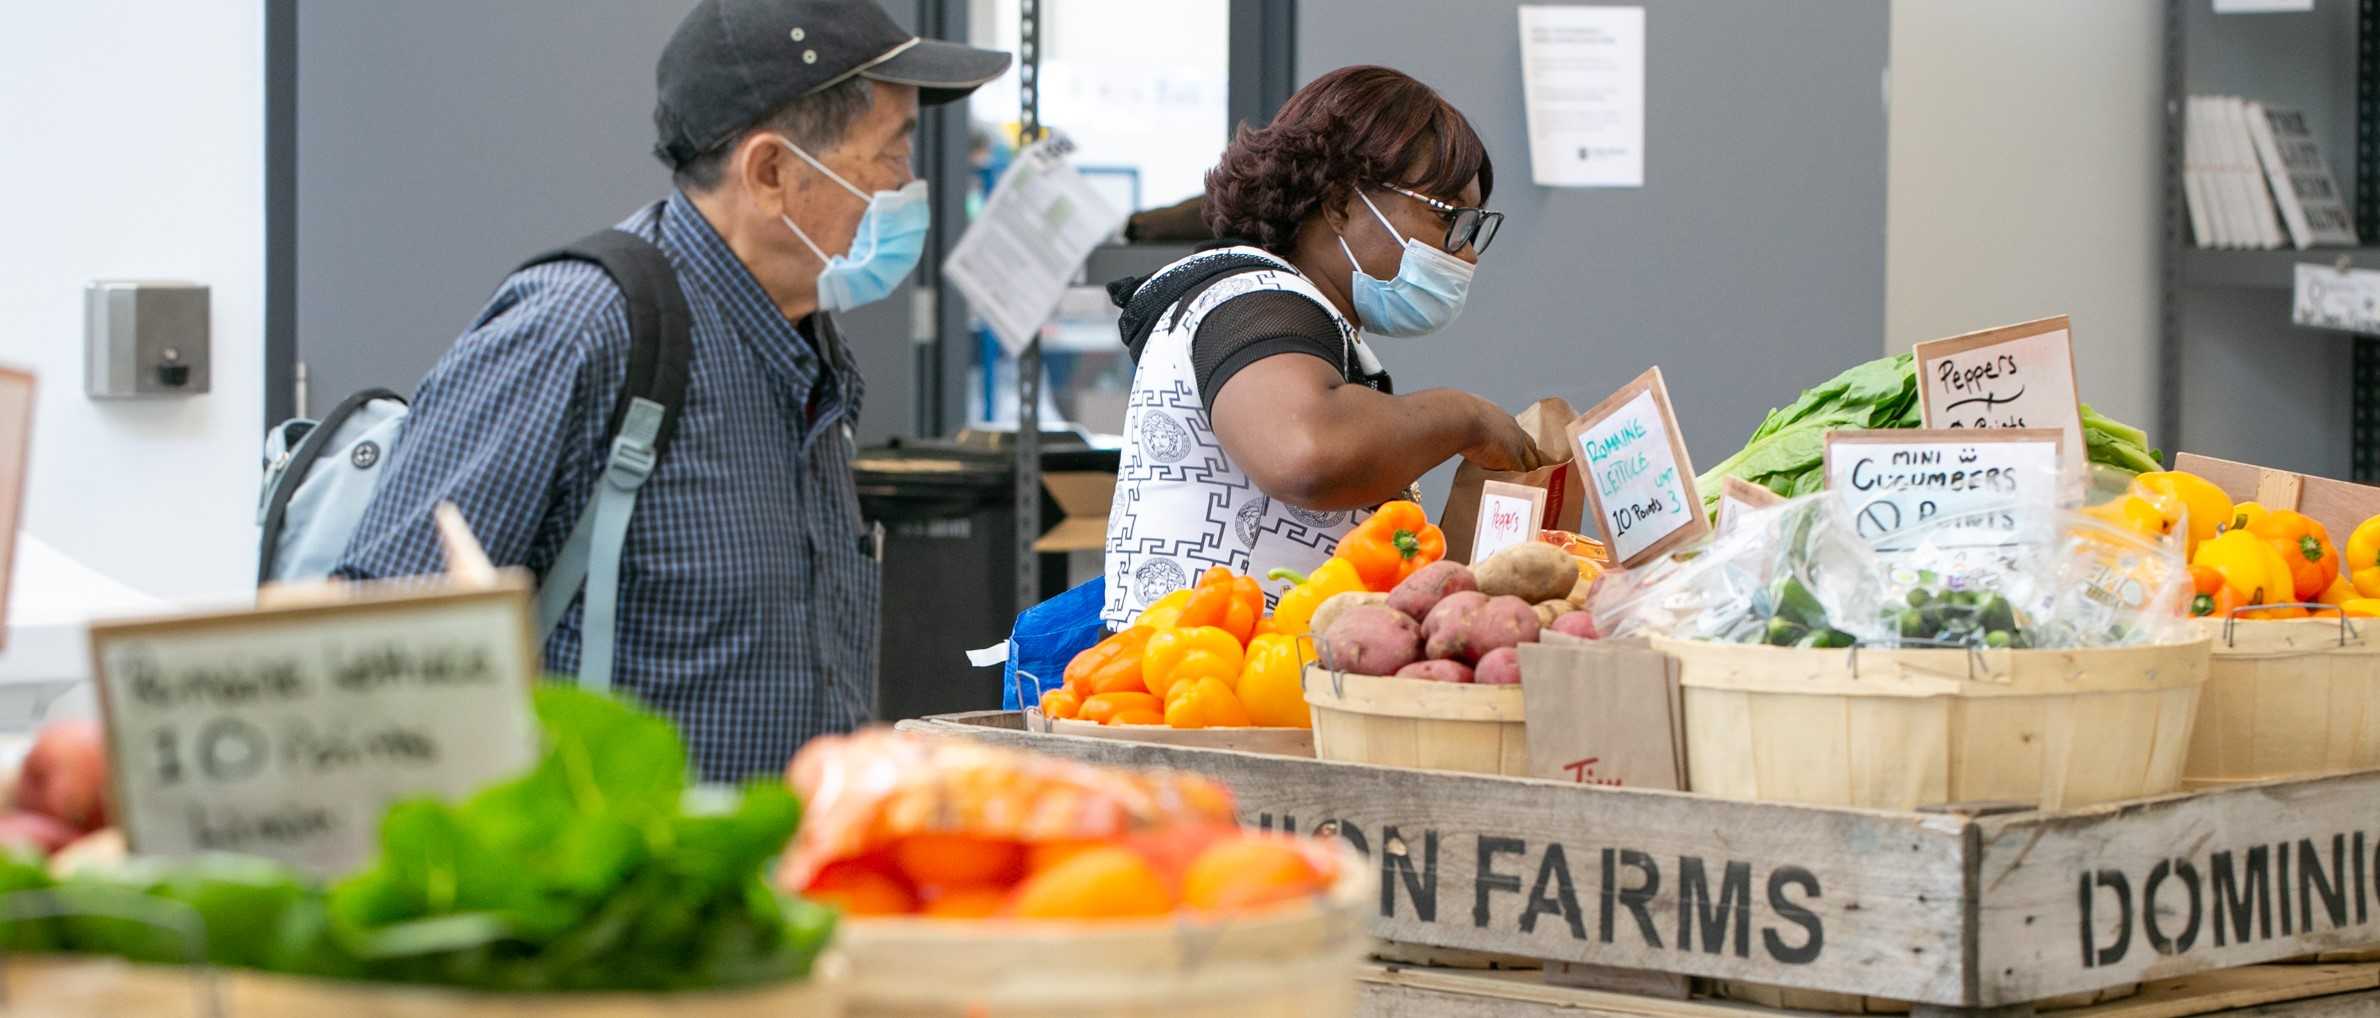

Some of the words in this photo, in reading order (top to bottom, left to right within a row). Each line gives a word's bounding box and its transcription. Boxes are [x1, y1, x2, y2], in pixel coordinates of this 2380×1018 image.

[1938, 354, 2017, 394] Peppers
[1586, 417, 1647, 465] ROMAINE
[1892, 449, 1942, 466] MINI
[1668, 489, 1681, 514] 3
[1612, 506, 1632, 538] 10
[1474, 833, 1824, 964] FARMS
[2076, 829, 2380, 969] DOMINI
